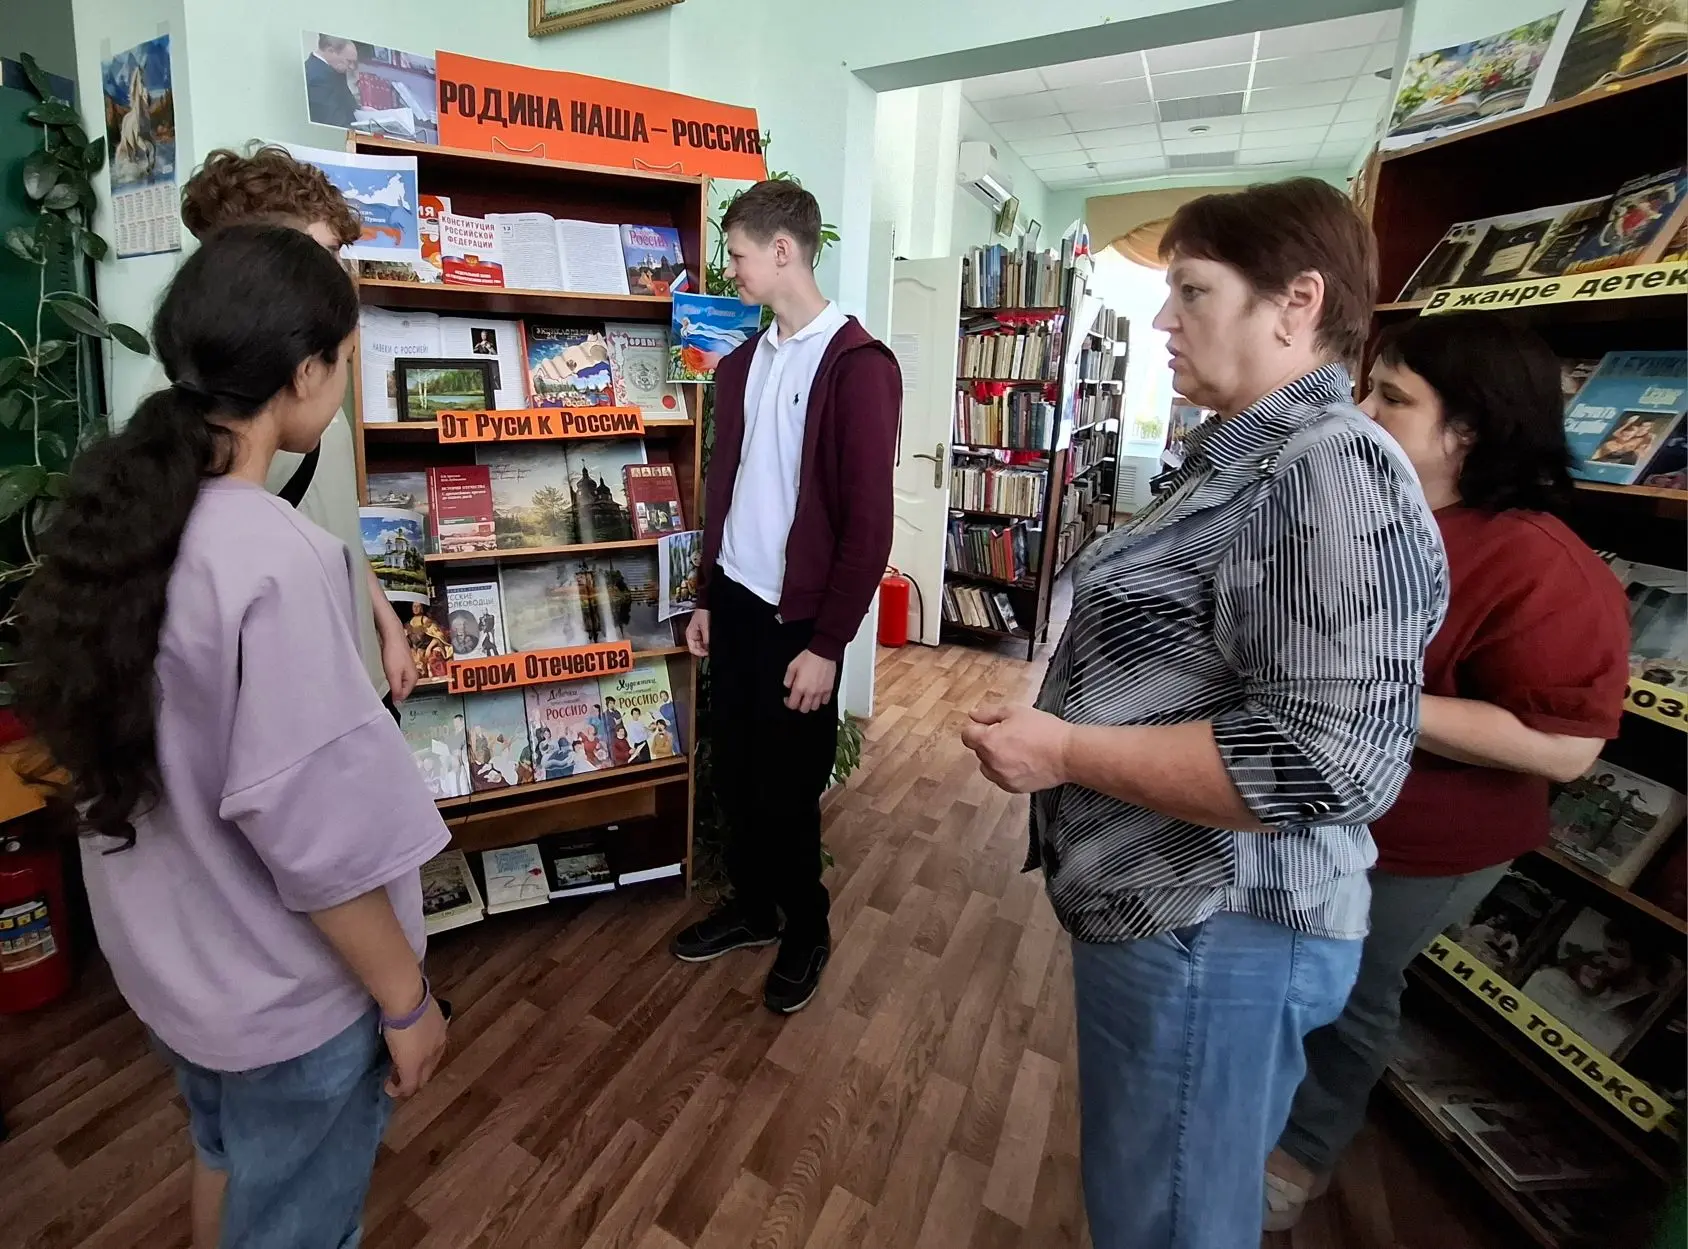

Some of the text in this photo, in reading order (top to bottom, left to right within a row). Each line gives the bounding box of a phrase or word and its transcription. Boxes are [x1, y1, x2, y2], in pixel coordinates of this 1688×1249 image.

[439, 79, 563, 131] РОДИНА
[570, 101, 648, 144] НАША
[671, 118, 763, 155] РОССИЯ
[441, 216, 495, 231] КОНСТИТУЦИЯ
[444, 225, 494, 240] РОССИЙСКОЙ
[447, 235, 493, 249] ФЕДЕРАЦИИ
[1426, 291, 1452, 310] В
[1453, 281, 1561, 307] жанре
[441, 411, 639, 441] От Руси к России
[451, 649, 630, 691] Герои Отечества
[546, 703, 588, 720] РОССИЮ
[618, 693, 659, 709] РОССИЮ
[1453, 959, 1475, 982] и
[1479, 978, 1521, 1014] не
[1526, 1013, 1656, 1119] только
